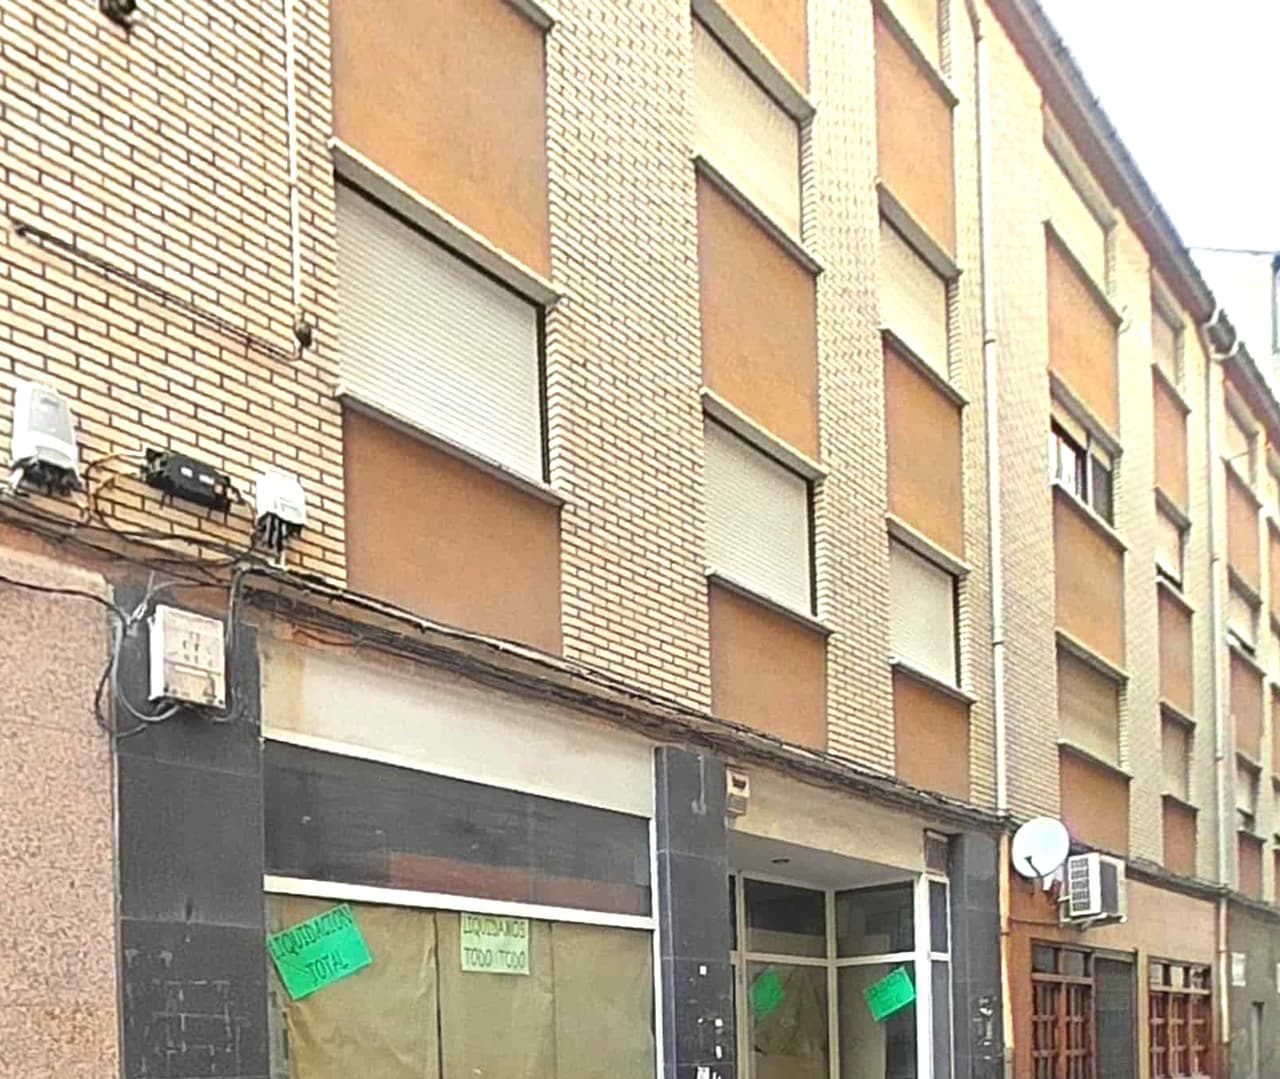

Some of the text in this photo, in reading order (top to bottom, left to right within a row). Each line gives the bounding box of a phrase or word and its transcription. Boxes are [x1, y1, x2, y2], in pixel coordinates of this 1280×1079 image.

[305, 950, 349, 986] TOTAL
[464, 946, 525, 969] TODO TODO
